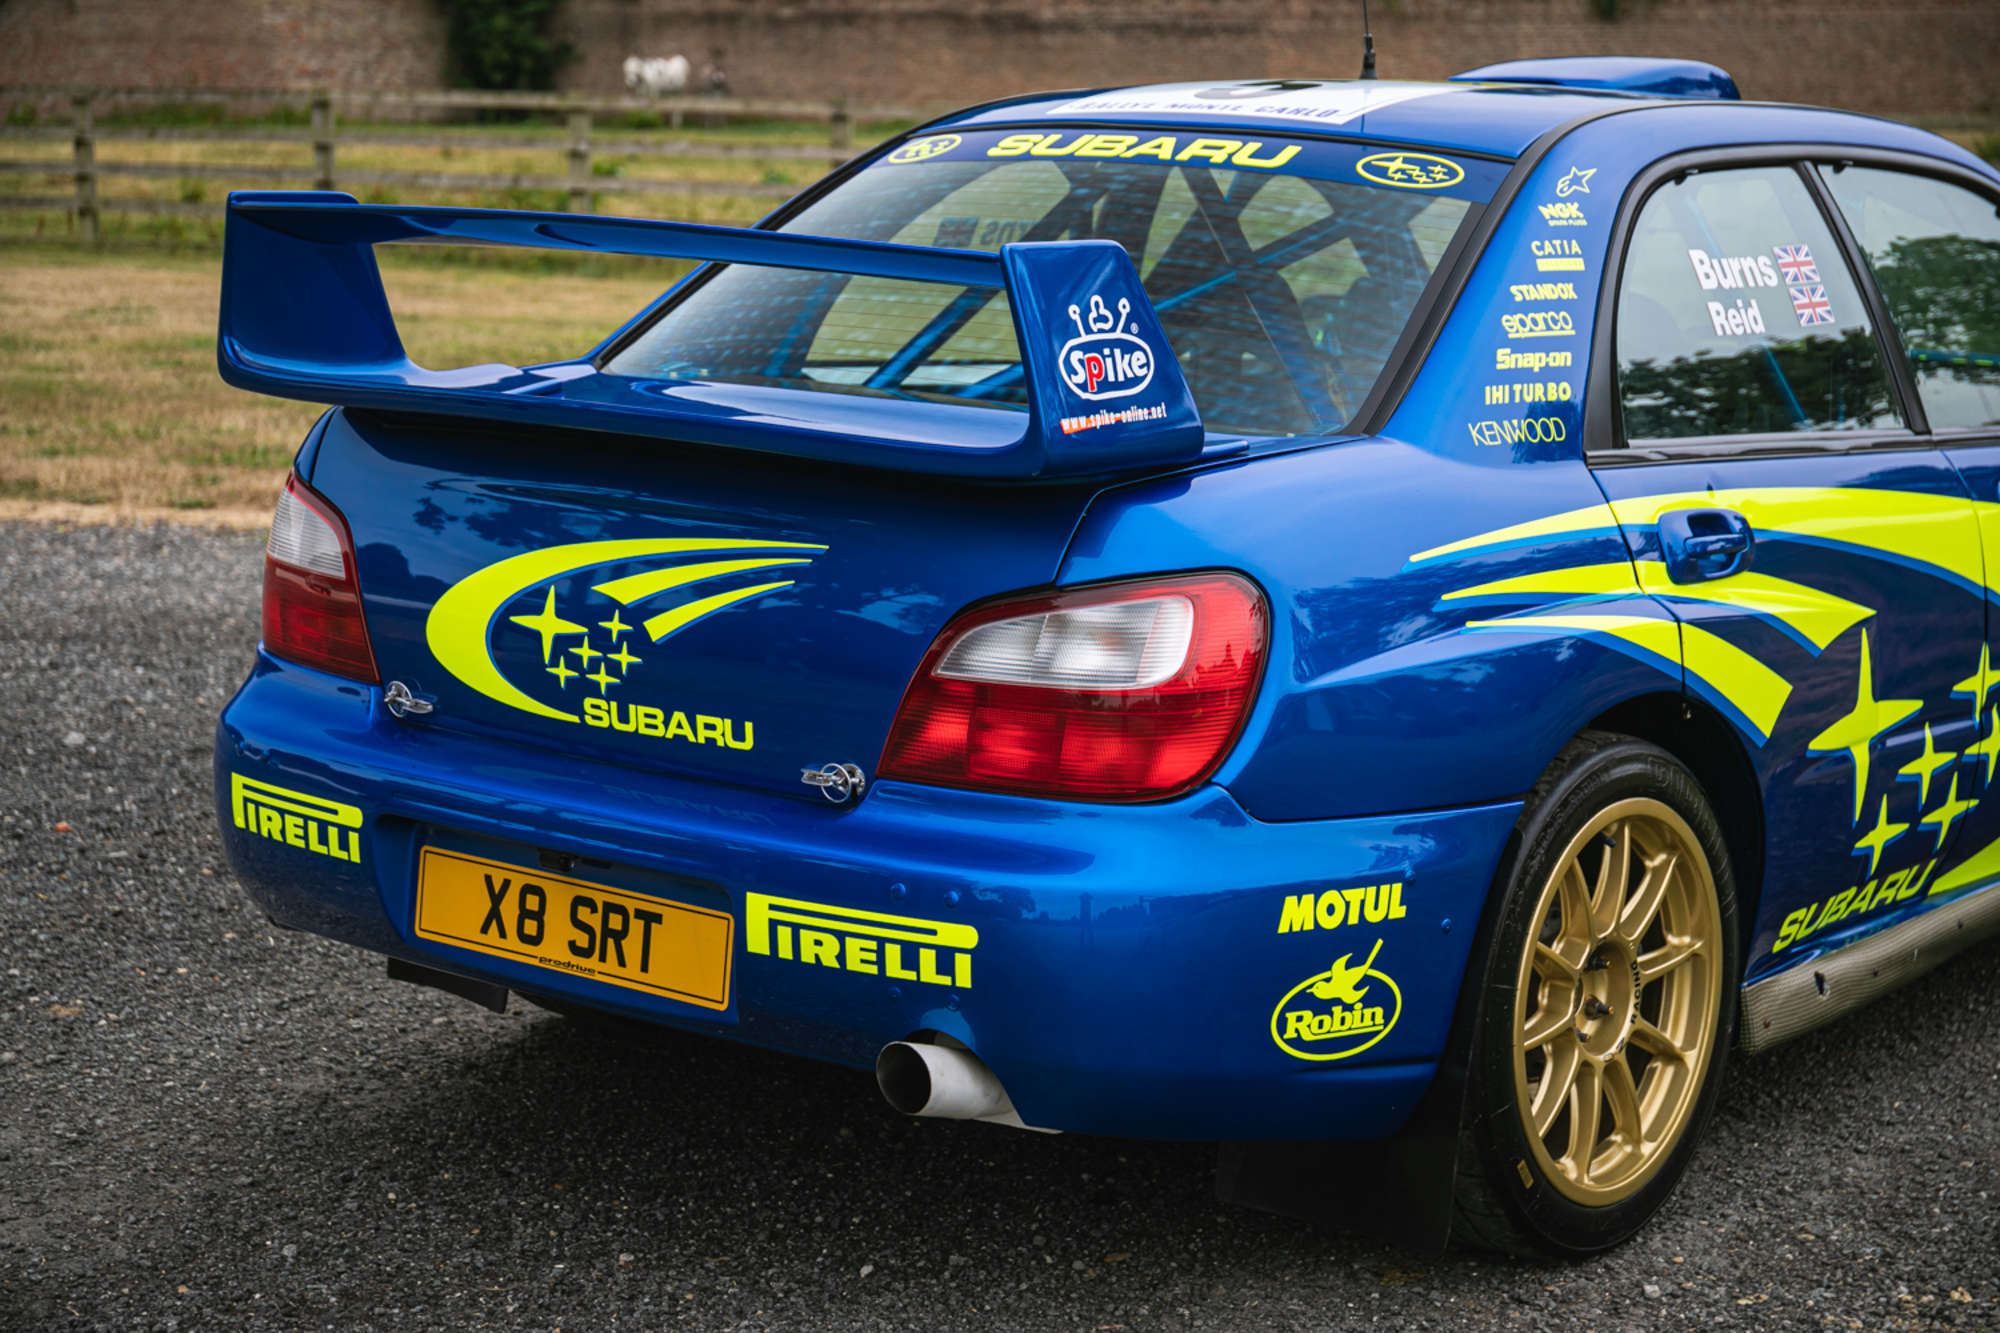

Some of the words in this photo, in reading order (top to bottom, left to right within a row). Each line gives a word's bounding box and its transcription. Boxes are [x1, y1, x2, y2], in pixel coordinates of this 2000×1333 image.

[987, 134, 1302, 168] SUBARU
[1531, 240, 1582, 256] CATIA
[1688, 249, 1778, 290] Burns
[1510, 283, 1578, 302] STANDOX
[1501, 311, 1576, 338] sparco
[1707, 299, 1766, 337] Reid
[1070, 347, 1148, 392] Spike
[1496, 348, 1572, 372] Snap-on
[1485, 384, 1510, 405] IHI
[1513, 381, 1572, 403] TURBO
[1060, 402, 1167, 431] www.spike-online.net
[1468, 417, 1566, 446] KENWOOD
[583, 697, 754, 751] SUBARU
[231, 772, 363, 864] PIRELLI
[479, 873, 546, 947] X8
[567, 895, 664, 974] SRT
[1277, 882, 1407, 934] MOTUL
[1772, 858, 1938, 954] SUBARU
[745, 891, 979, 989] PIRELLI
[538, 956, 597, 976] prodrive
[1284, 1002, 1385, 1042] Robin
